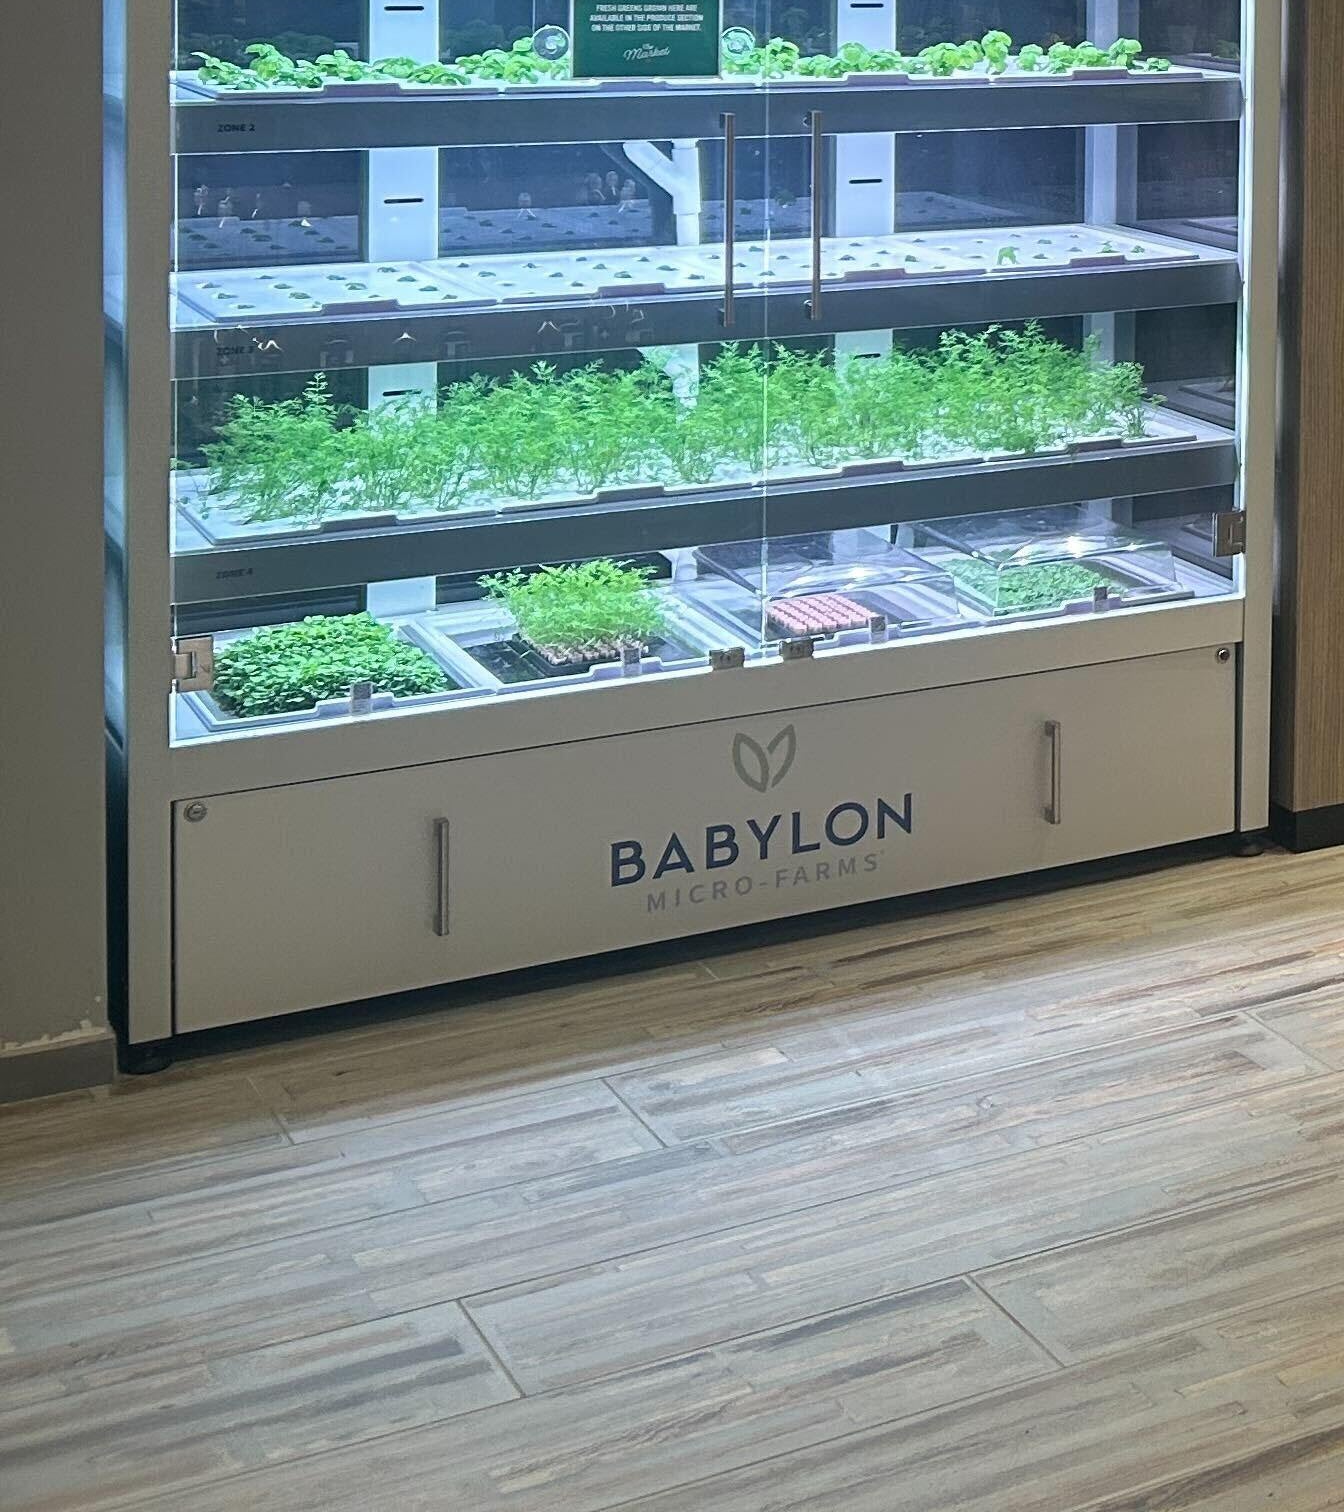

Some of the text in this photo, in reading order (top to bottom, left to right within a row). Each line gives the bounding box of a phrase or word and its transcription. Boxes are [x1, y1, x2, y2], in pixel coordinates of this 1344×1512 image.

[596, 4, 698, 12] FRESH GREENS GROWN HERE ARE
[590, 14, 703, 22] AVAILABLE IN THE PRODUCE SECTION
[591, 24, 601, 32] ON
[602, 24, 614, 32] THE
[616, 24, 636, 32] OTHER
[637, 24, 651, 32] SIDE
[653, 24, 661, 32] OF
[663, 24, 674, 32] THE
[623, 47, 670, 61] Market
[217, 124, 246, 132] ZONE
[610, 792, 913, 888] BABYLON
[646, 852, 880, 914] MICRO-FARMS
